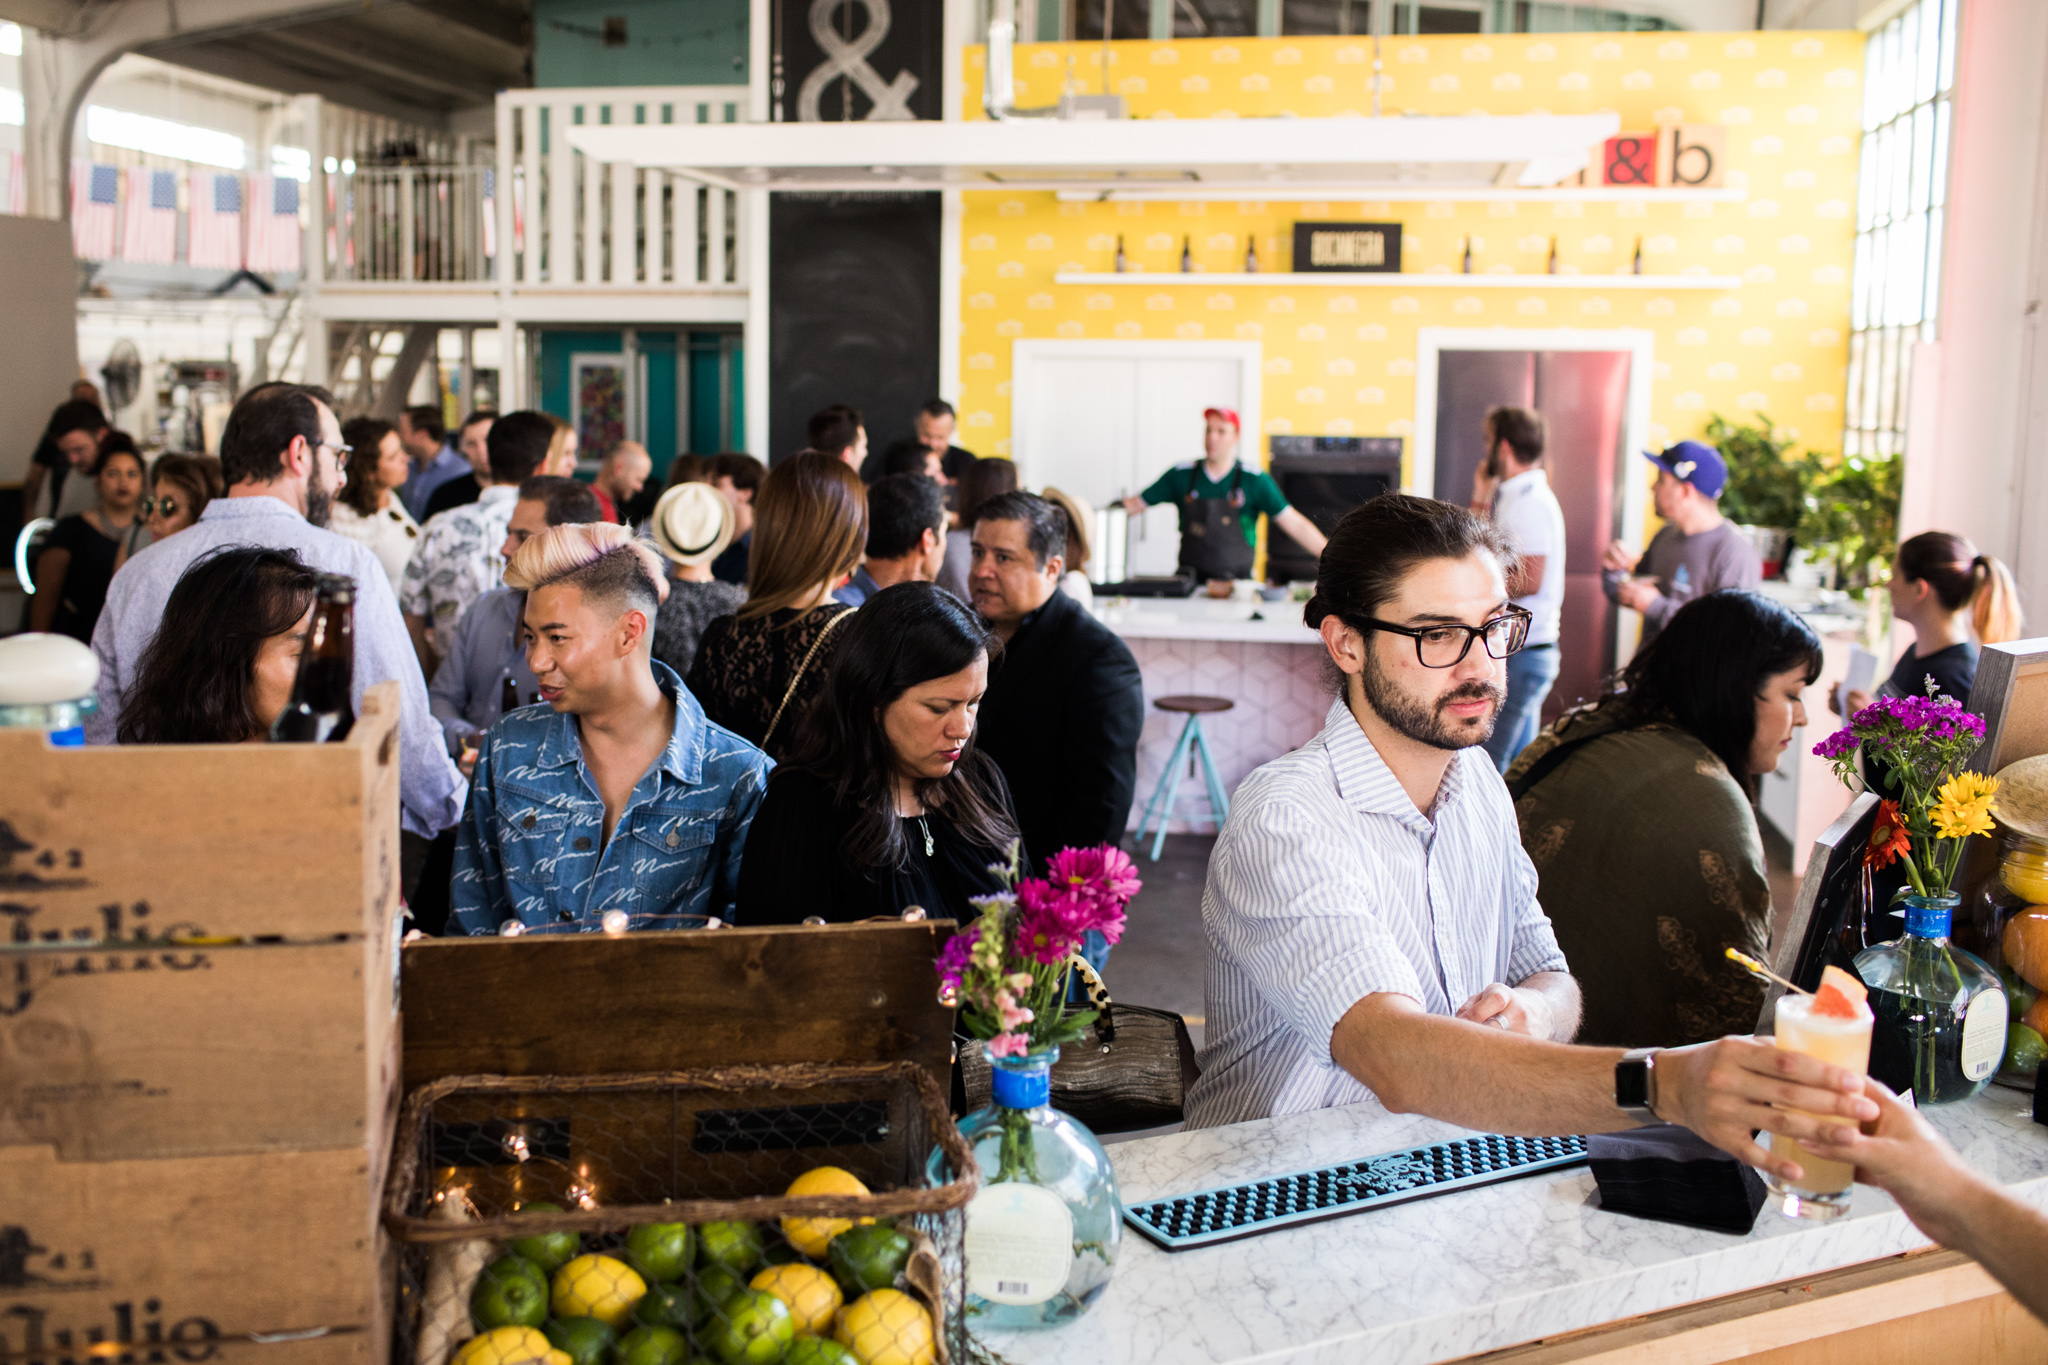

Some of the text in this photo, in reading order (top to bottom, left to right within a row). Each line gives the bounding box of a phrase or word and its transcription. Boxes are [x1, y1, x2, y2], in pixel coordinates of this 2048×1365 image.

[796, 0, 920, 121] &
[1608, 129, 1713, 185] & b
